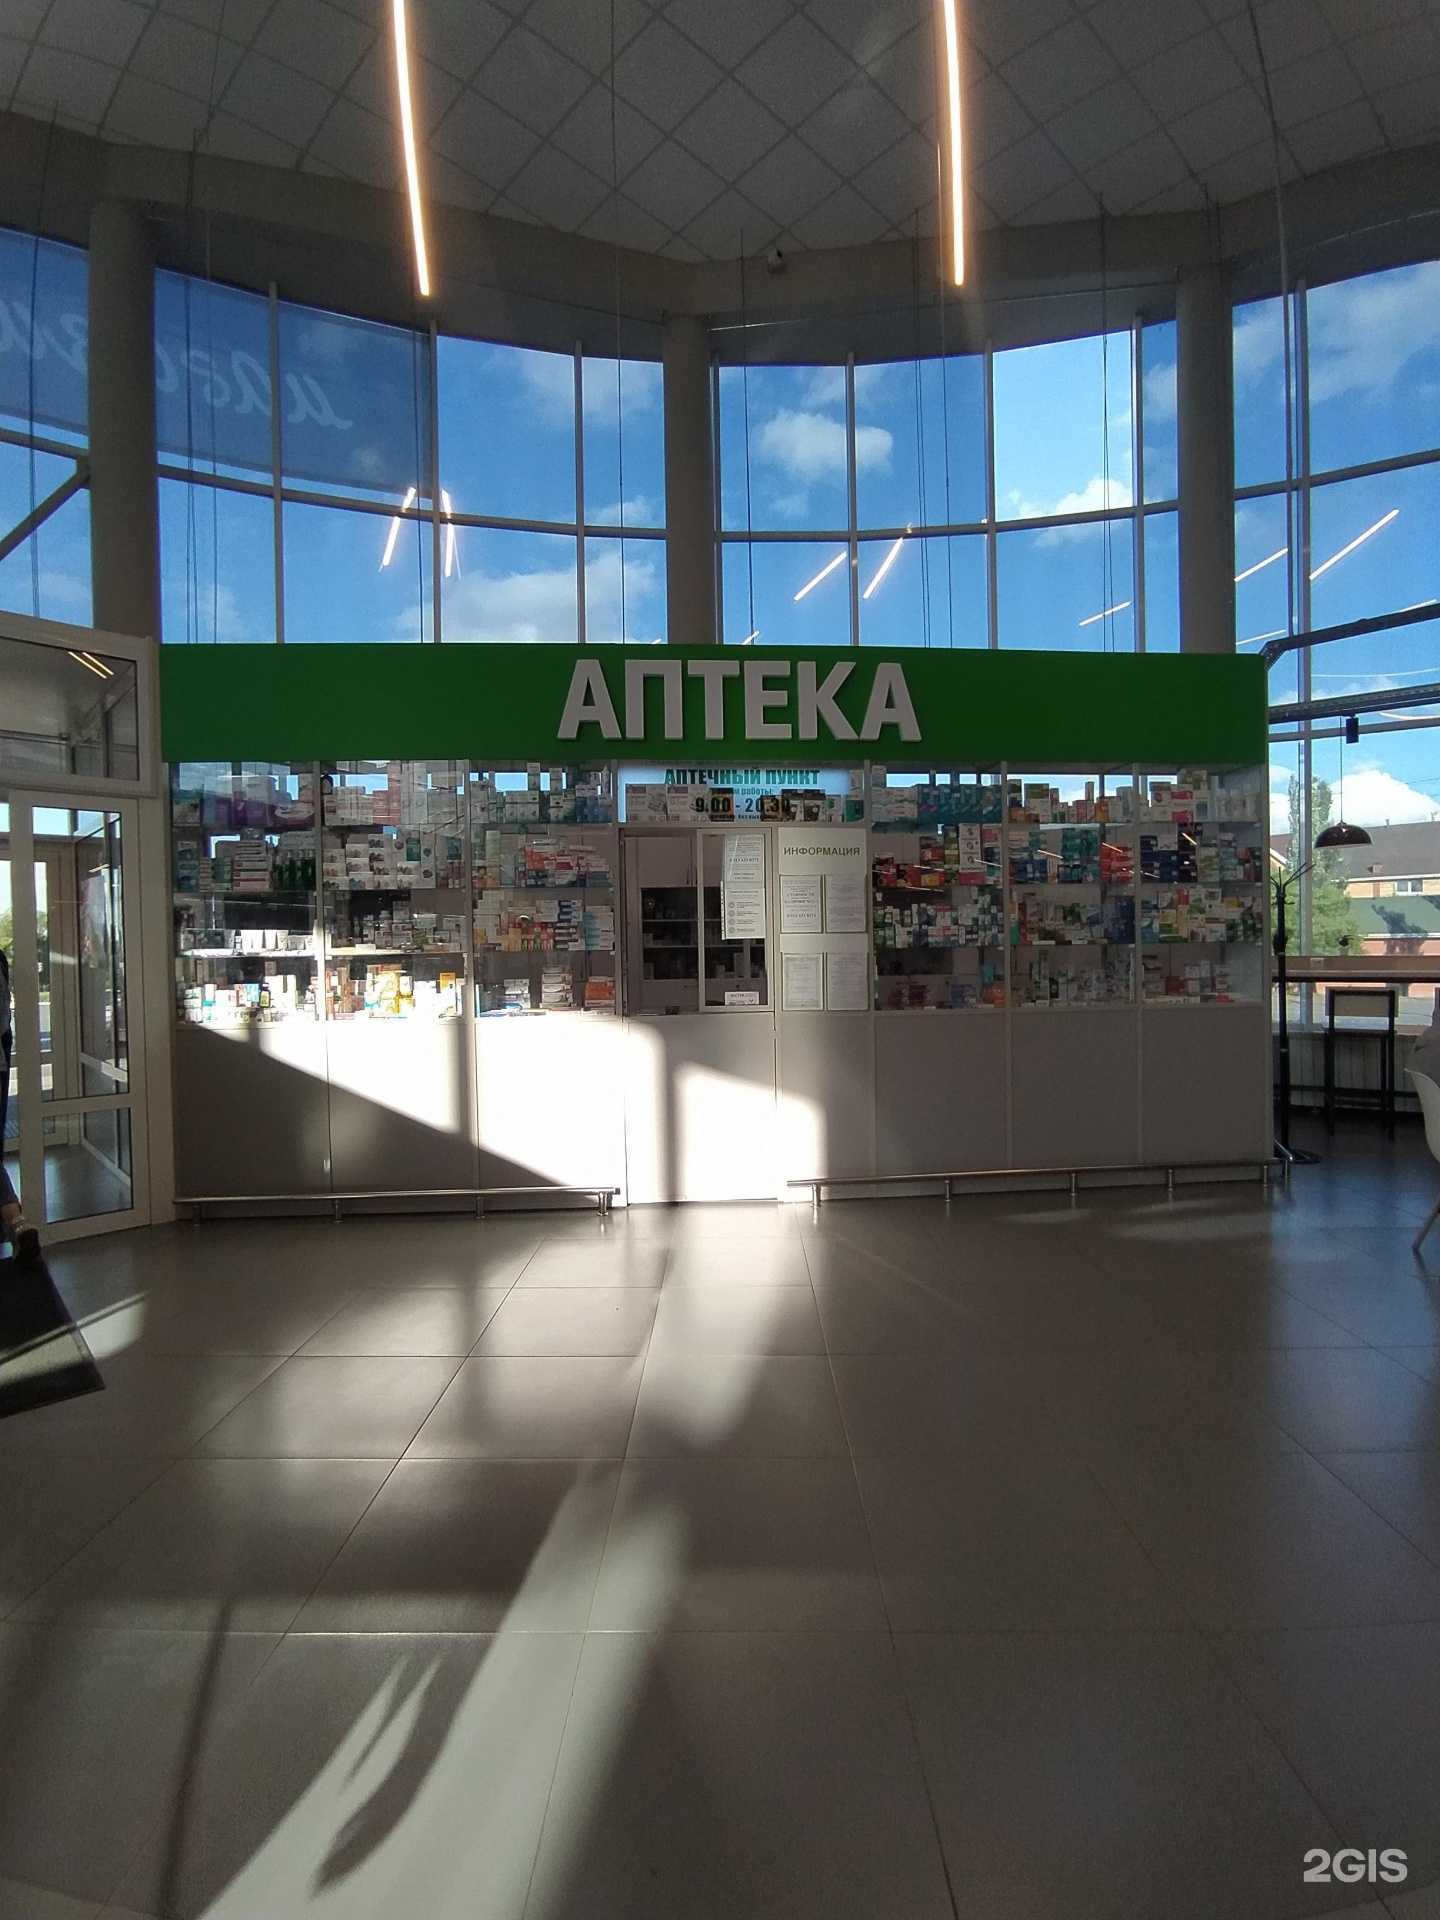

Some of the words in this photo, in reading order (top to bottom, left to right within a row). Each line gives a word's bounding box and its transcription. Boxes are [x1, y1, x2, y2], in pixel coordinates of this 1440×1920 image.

[556, 659, 922, 742] АПТЕКА
[664, 767, 762, 784] АПТЕЧНЫЙ
[766, 768, 820, 784] ПУНКТ
[695, 796, 731, 813] 9.00
[783, 847, 861, 856] ИНФОРМАЦИЯ
